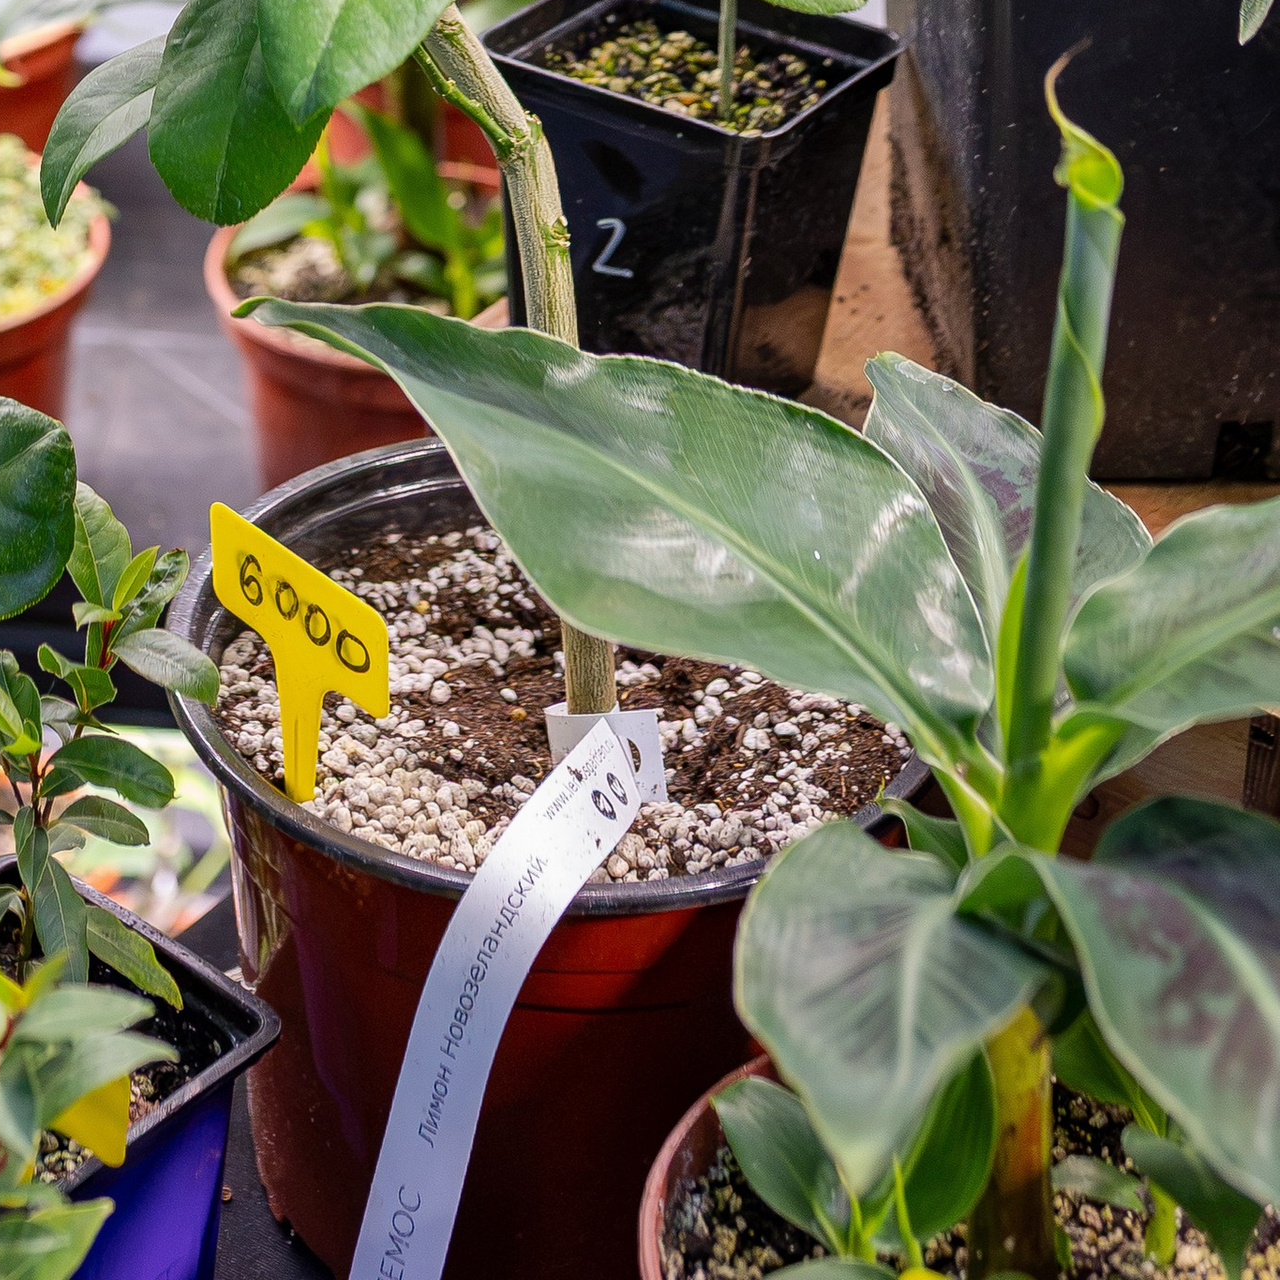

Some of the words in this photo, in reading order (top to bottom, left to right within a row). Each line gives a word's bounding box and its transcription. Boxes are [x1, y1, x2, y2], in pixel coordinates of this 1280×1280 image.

[591, 217, 634, 278] 2
[239, 553, 371, 674] 6000
[418, 1063, 453, 1149] Лимон
[439, 853, 548, 1060] Новозеландский
[376, 1184, 422, 1280] ЕМОС
